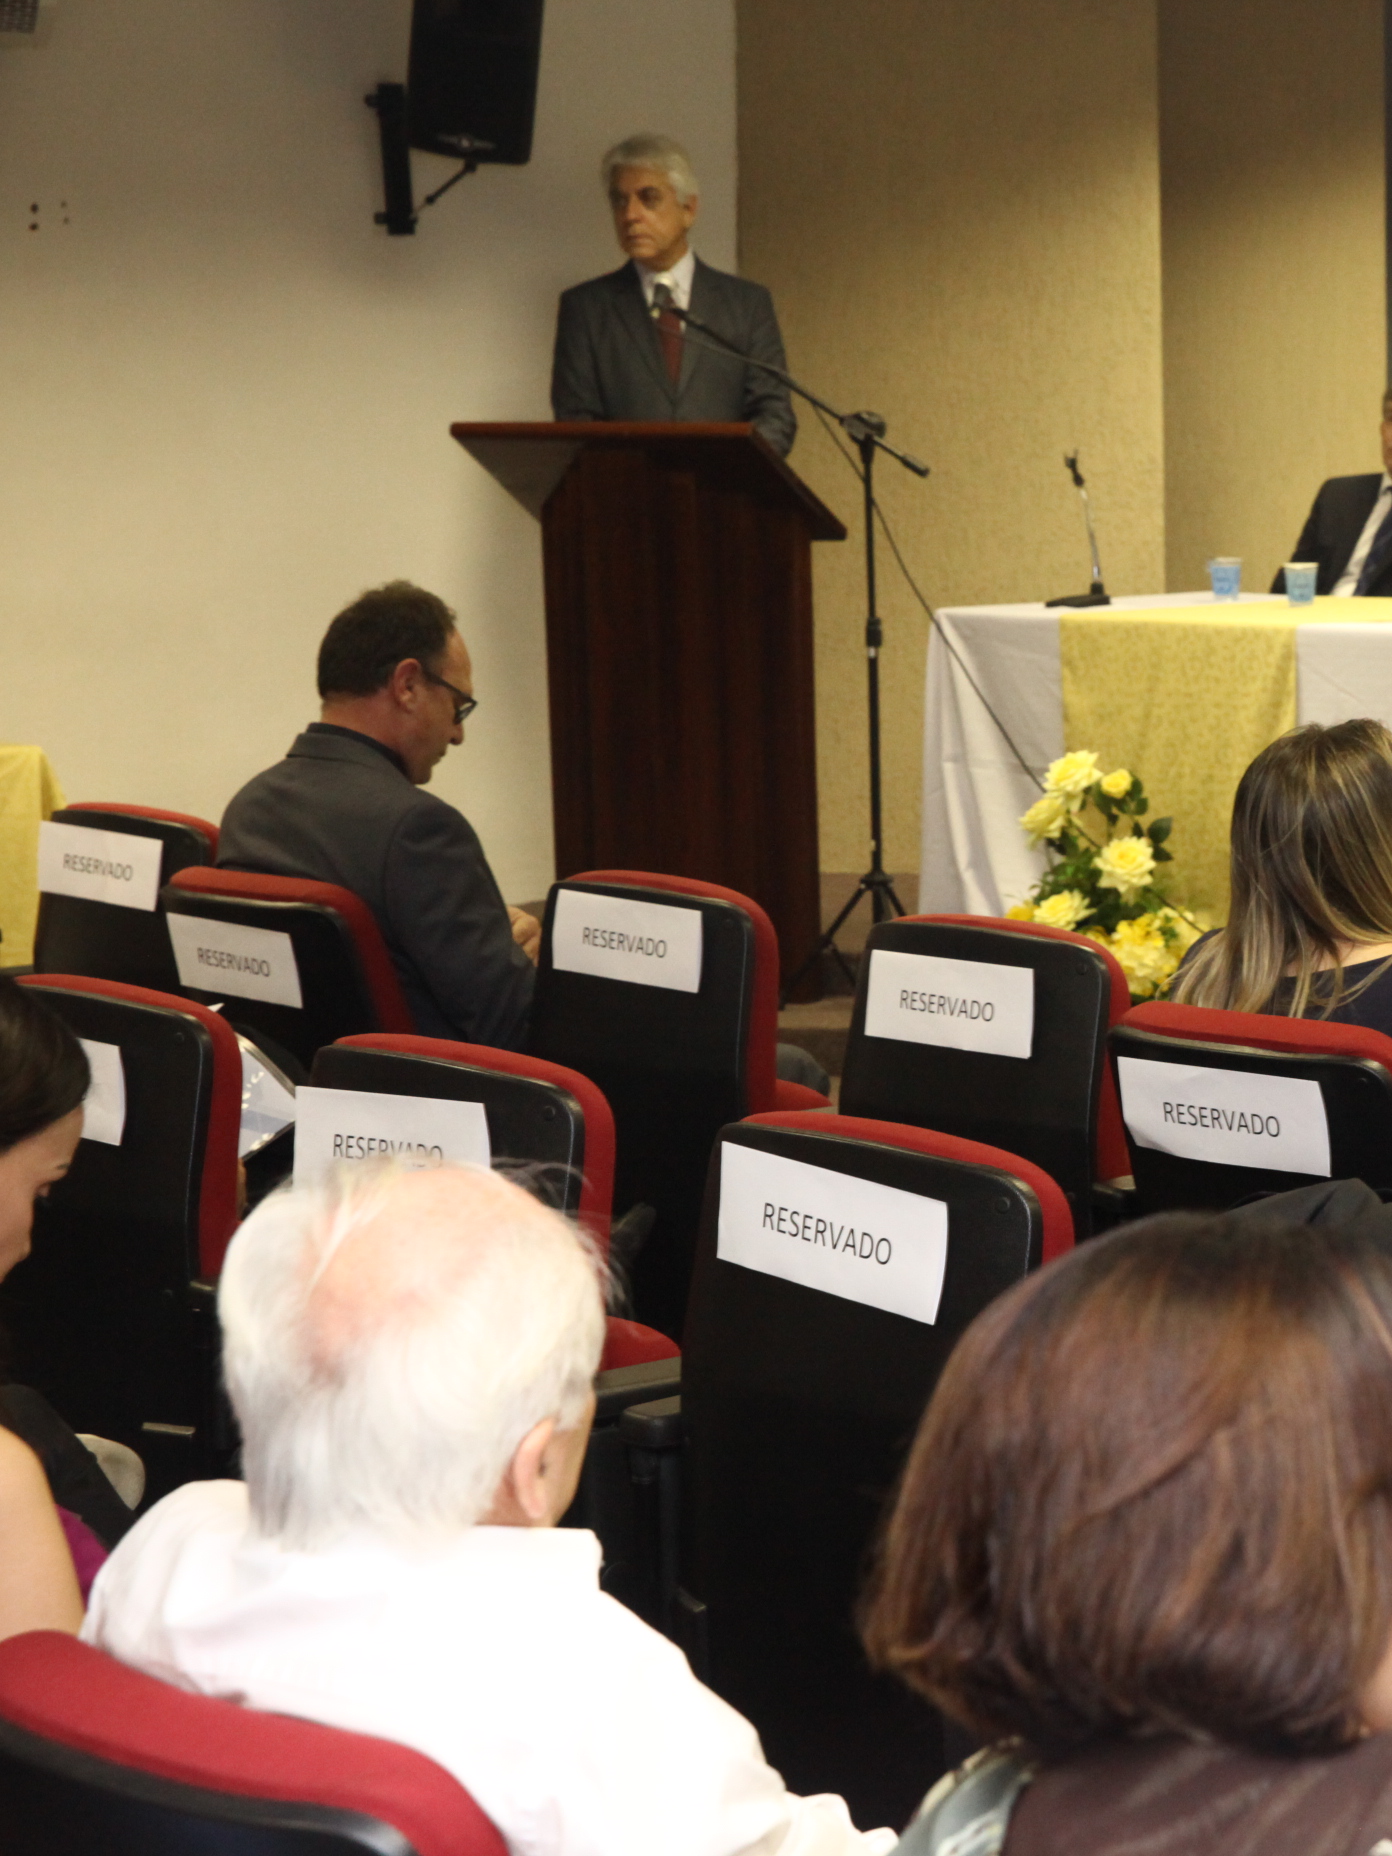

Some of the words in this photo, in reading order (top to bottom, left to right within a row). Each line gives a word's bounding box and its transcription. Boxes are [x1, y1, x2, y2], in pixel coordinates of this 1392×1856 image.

[63, 853, 133, 882] RESERVADO
[582, 926, 667, 959] RESERVADO
[197, 947, 271, 978] RESERVADO
[899, 989, 995, 1023] RESERVADO
[1163, 1101, 1281, 1138] RESERVADO
[762, 1202, 892, 1266] RESERVADO
